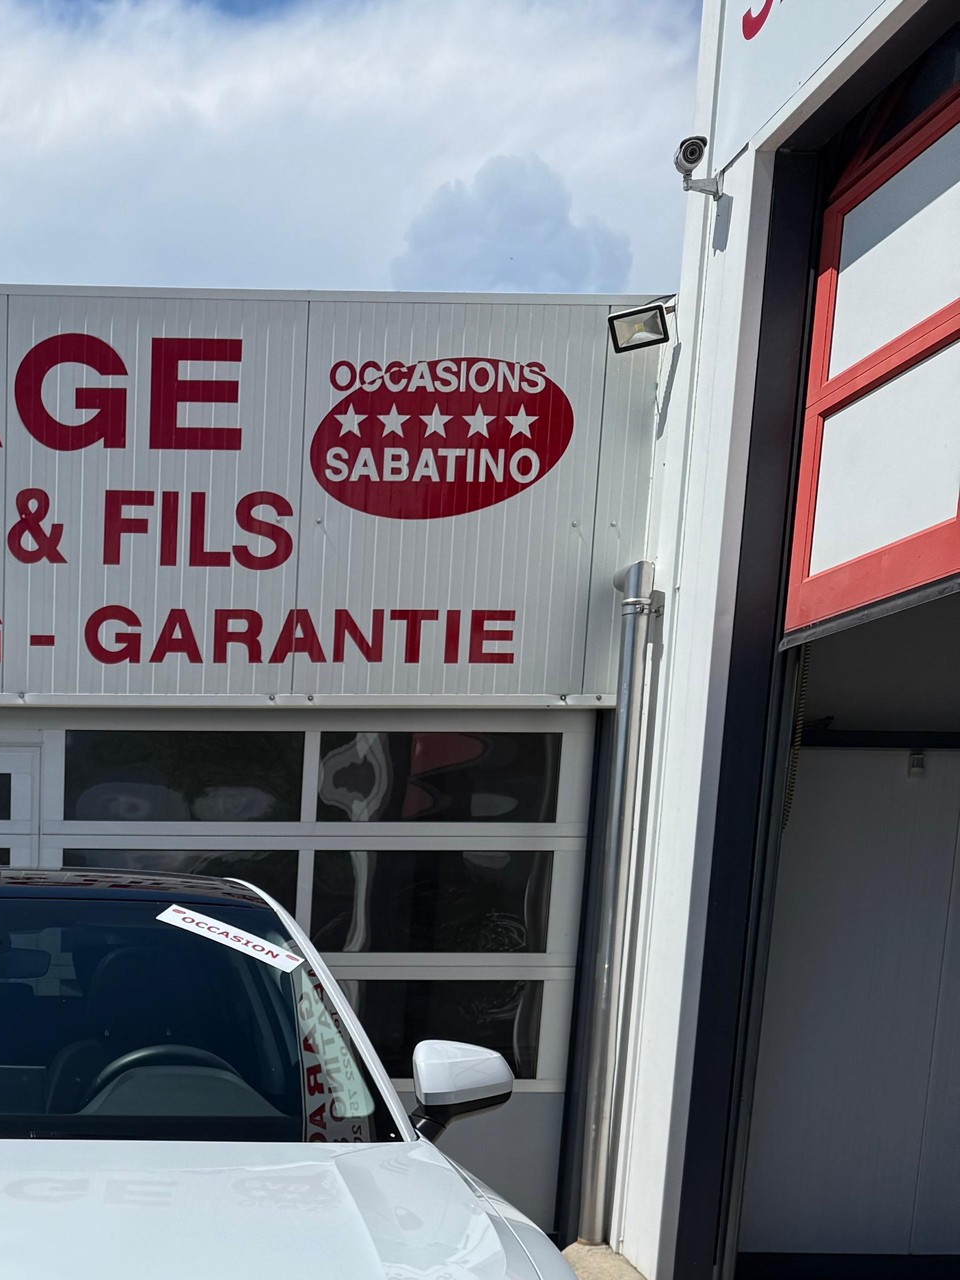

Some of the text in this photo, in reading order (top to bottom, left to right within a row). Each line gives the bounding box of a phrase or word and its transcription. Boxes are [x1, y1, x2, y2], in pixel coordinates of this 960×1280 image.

[329, 360, 547, 394] OCCASIONS
[324, 446, 541, 484] SABATINO
[7, 487, 67, 565] &
[103, 489, 293, 571] FILS
[84, 606, 516, 665] GARANTIE
[181, 916, 280, 959] OCCASION
